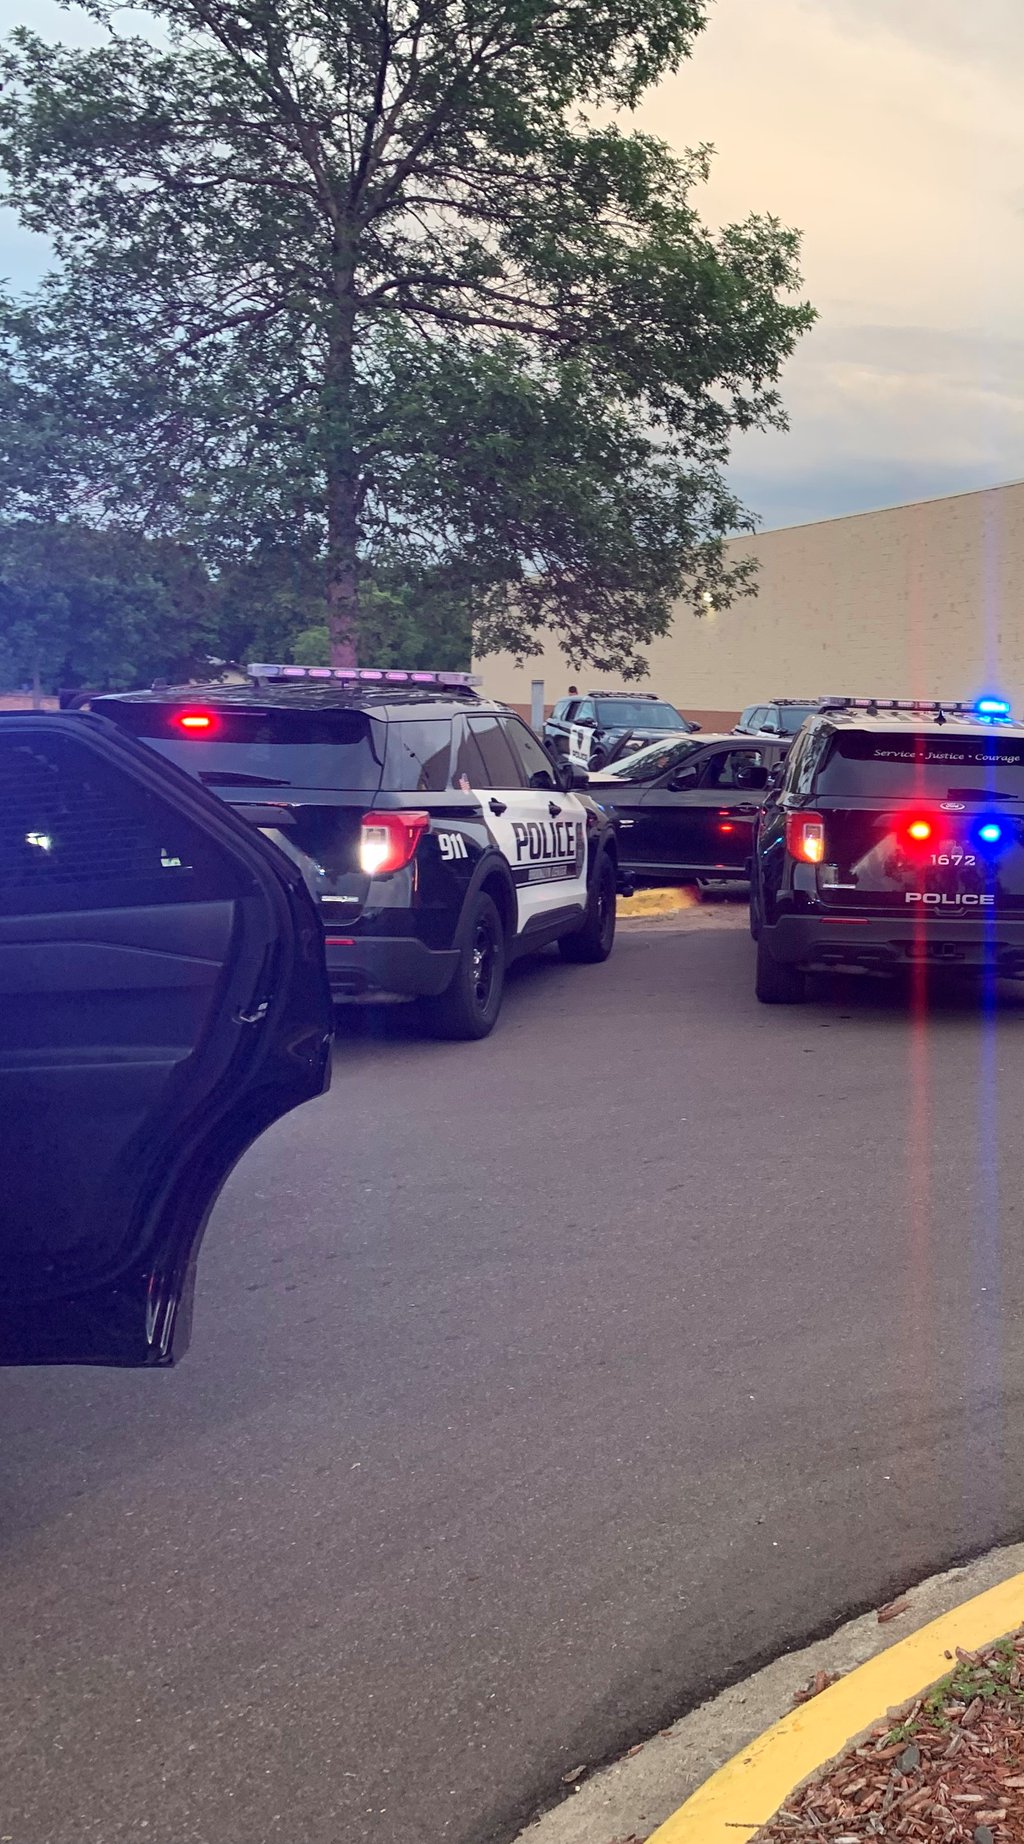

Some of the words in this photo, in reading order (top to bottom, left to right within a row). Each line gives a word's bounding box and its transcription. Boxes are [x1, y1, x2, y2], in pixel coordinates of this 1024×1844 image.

[874, 749, 916, 758] Service
[925, 752, 965, 760] Justice
[975, 753, 1021, 764] Courage
[438, 832, 469, 861] 911
[510, 821, 575, 861] POLICE
[930, 854, 976, 866] 1672
[905, 892, 995, 905] POLICE
